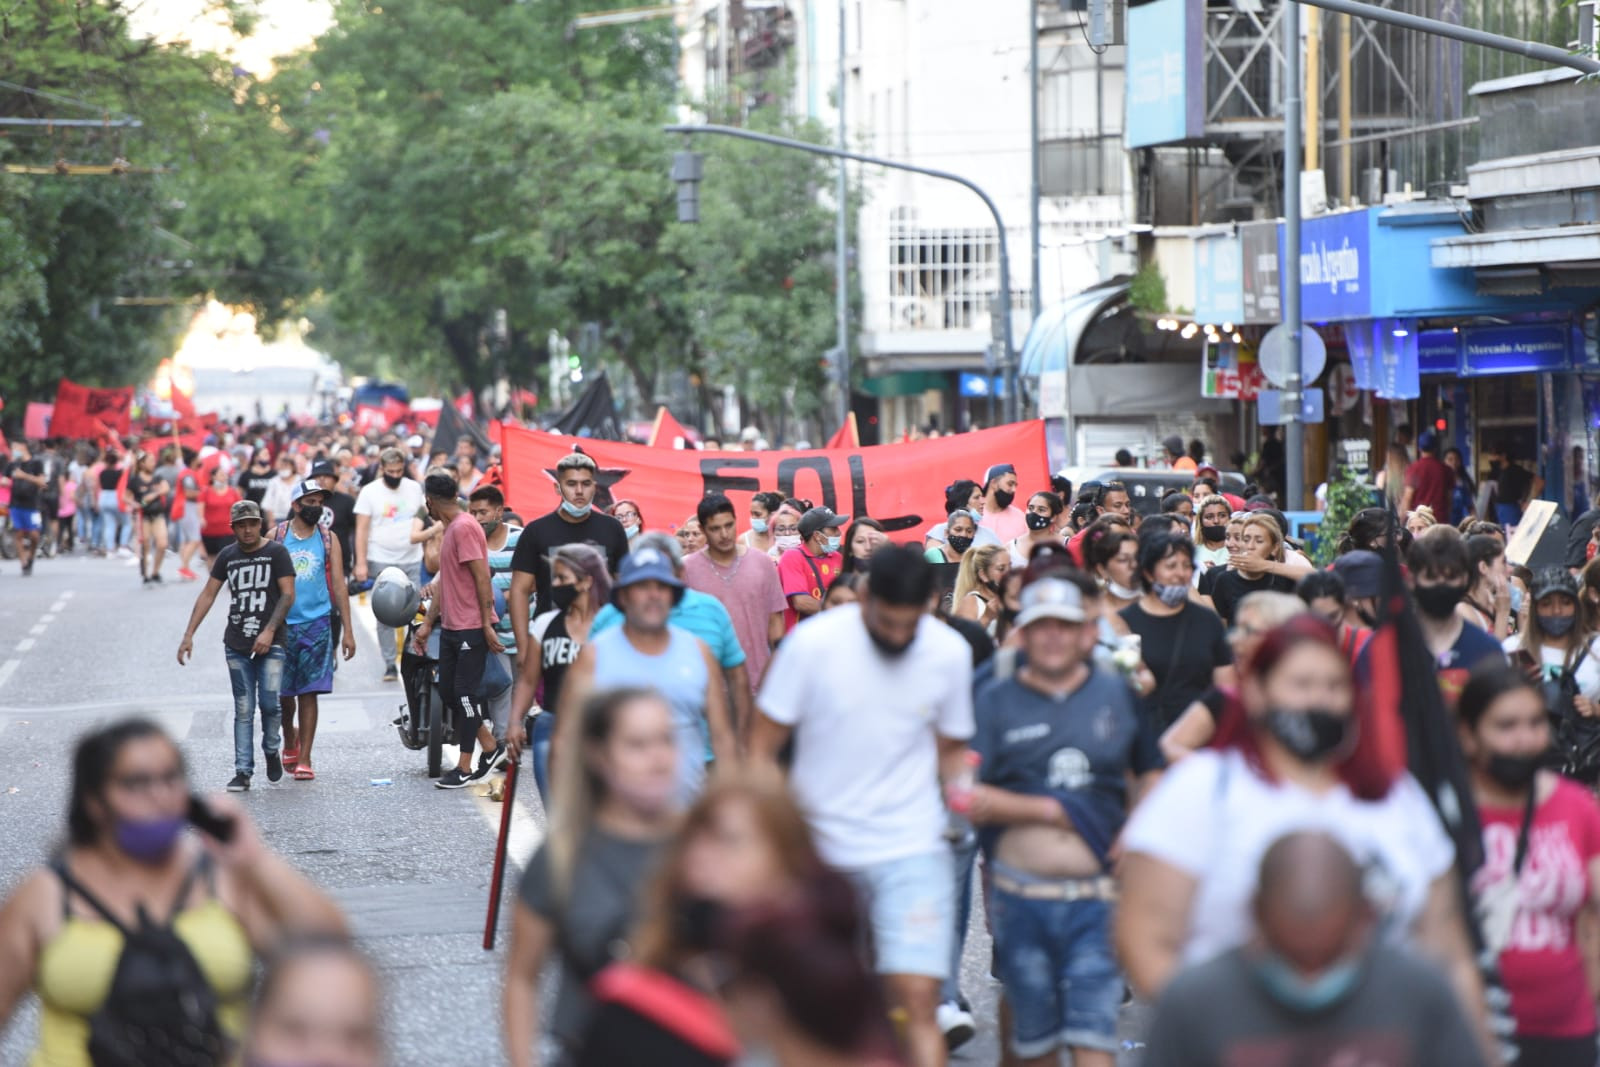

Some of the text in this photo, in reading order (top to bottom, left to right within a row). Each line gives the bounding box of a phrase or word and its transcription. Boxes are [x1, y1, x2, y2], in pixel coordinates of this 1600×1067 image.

[1468, 340, 1563, 355] Mercado Argentino
[227, 564, 271, 590] YOU
